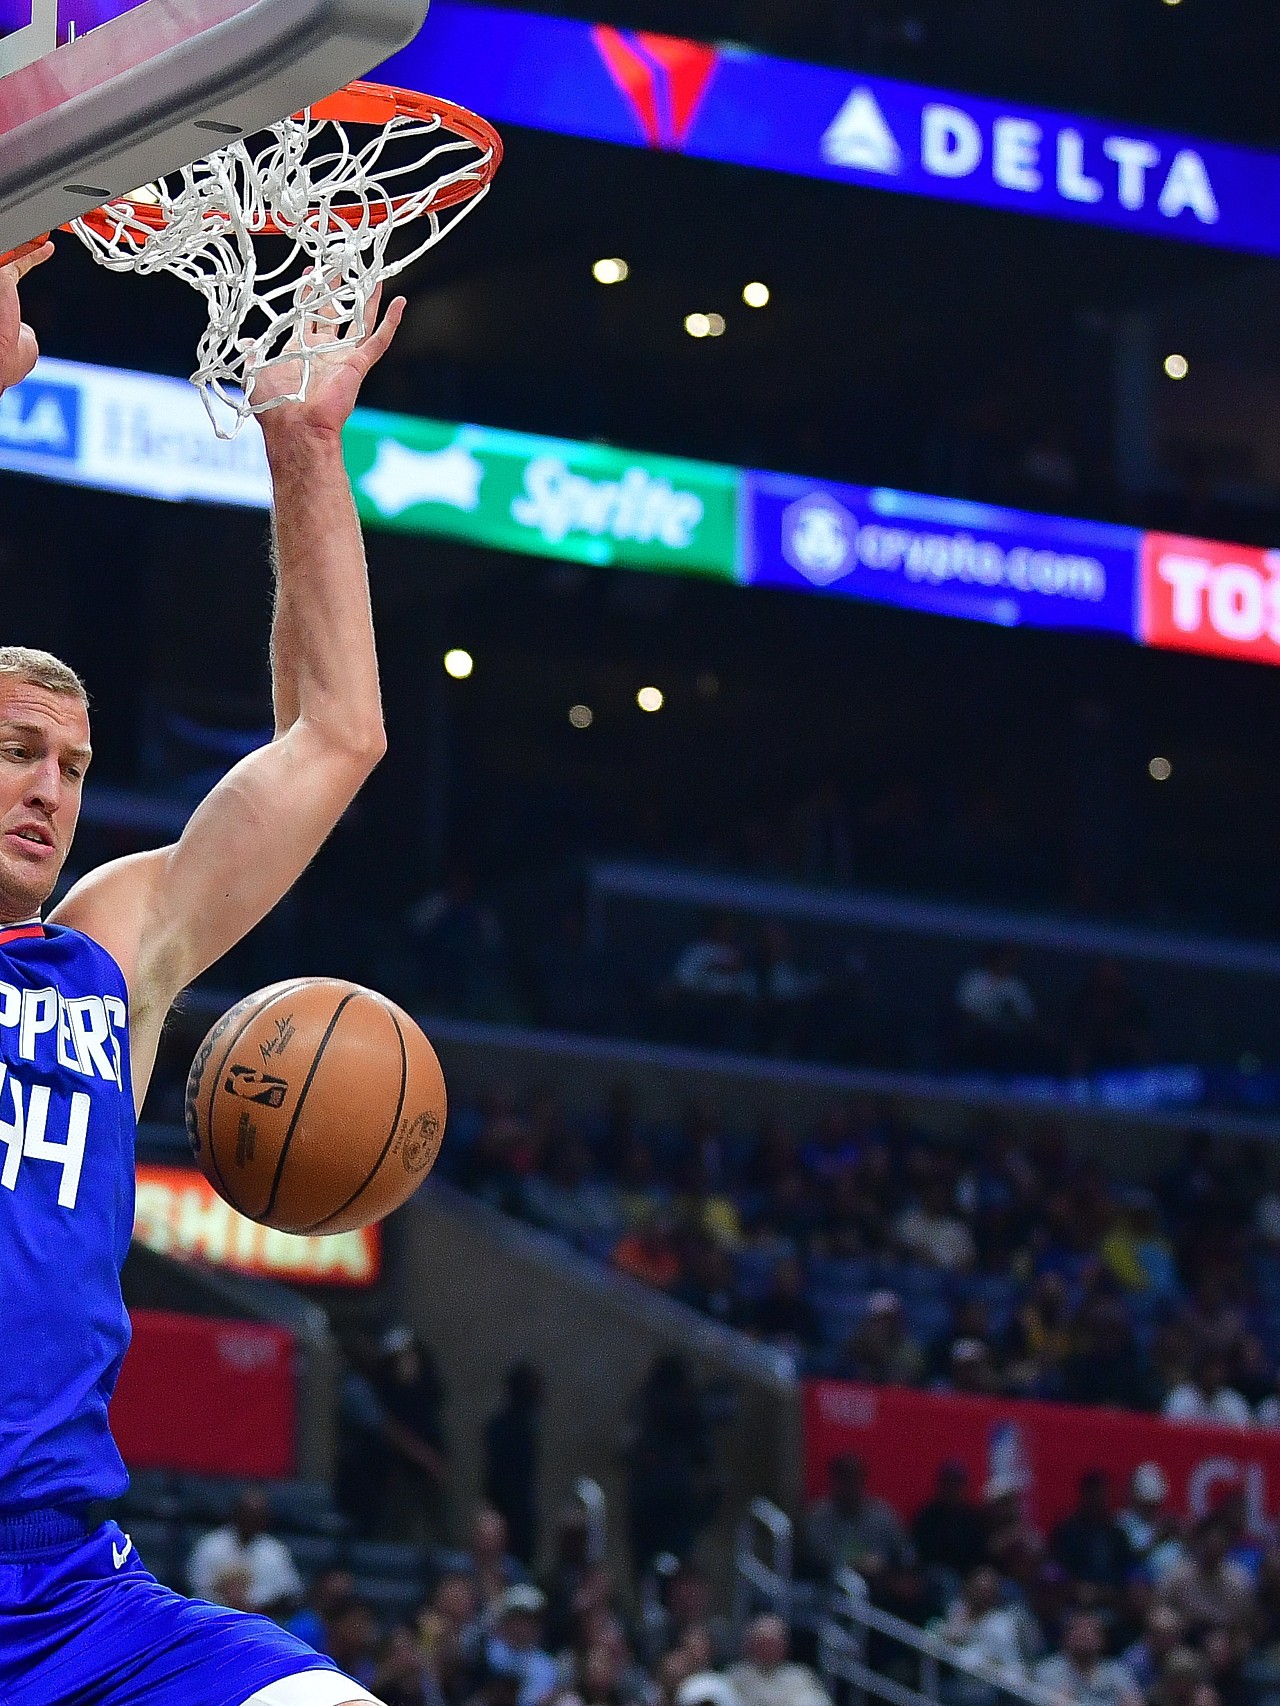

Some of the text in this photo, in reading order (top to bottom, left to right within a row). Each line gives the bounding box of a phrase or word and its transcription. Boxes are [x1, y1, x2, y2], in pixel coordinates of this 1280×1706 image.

[922, 103, 1219, 224] DELTA
[511, 456, 703, 548] Sprite
[855, 523, 1106, 601] crypto.com
